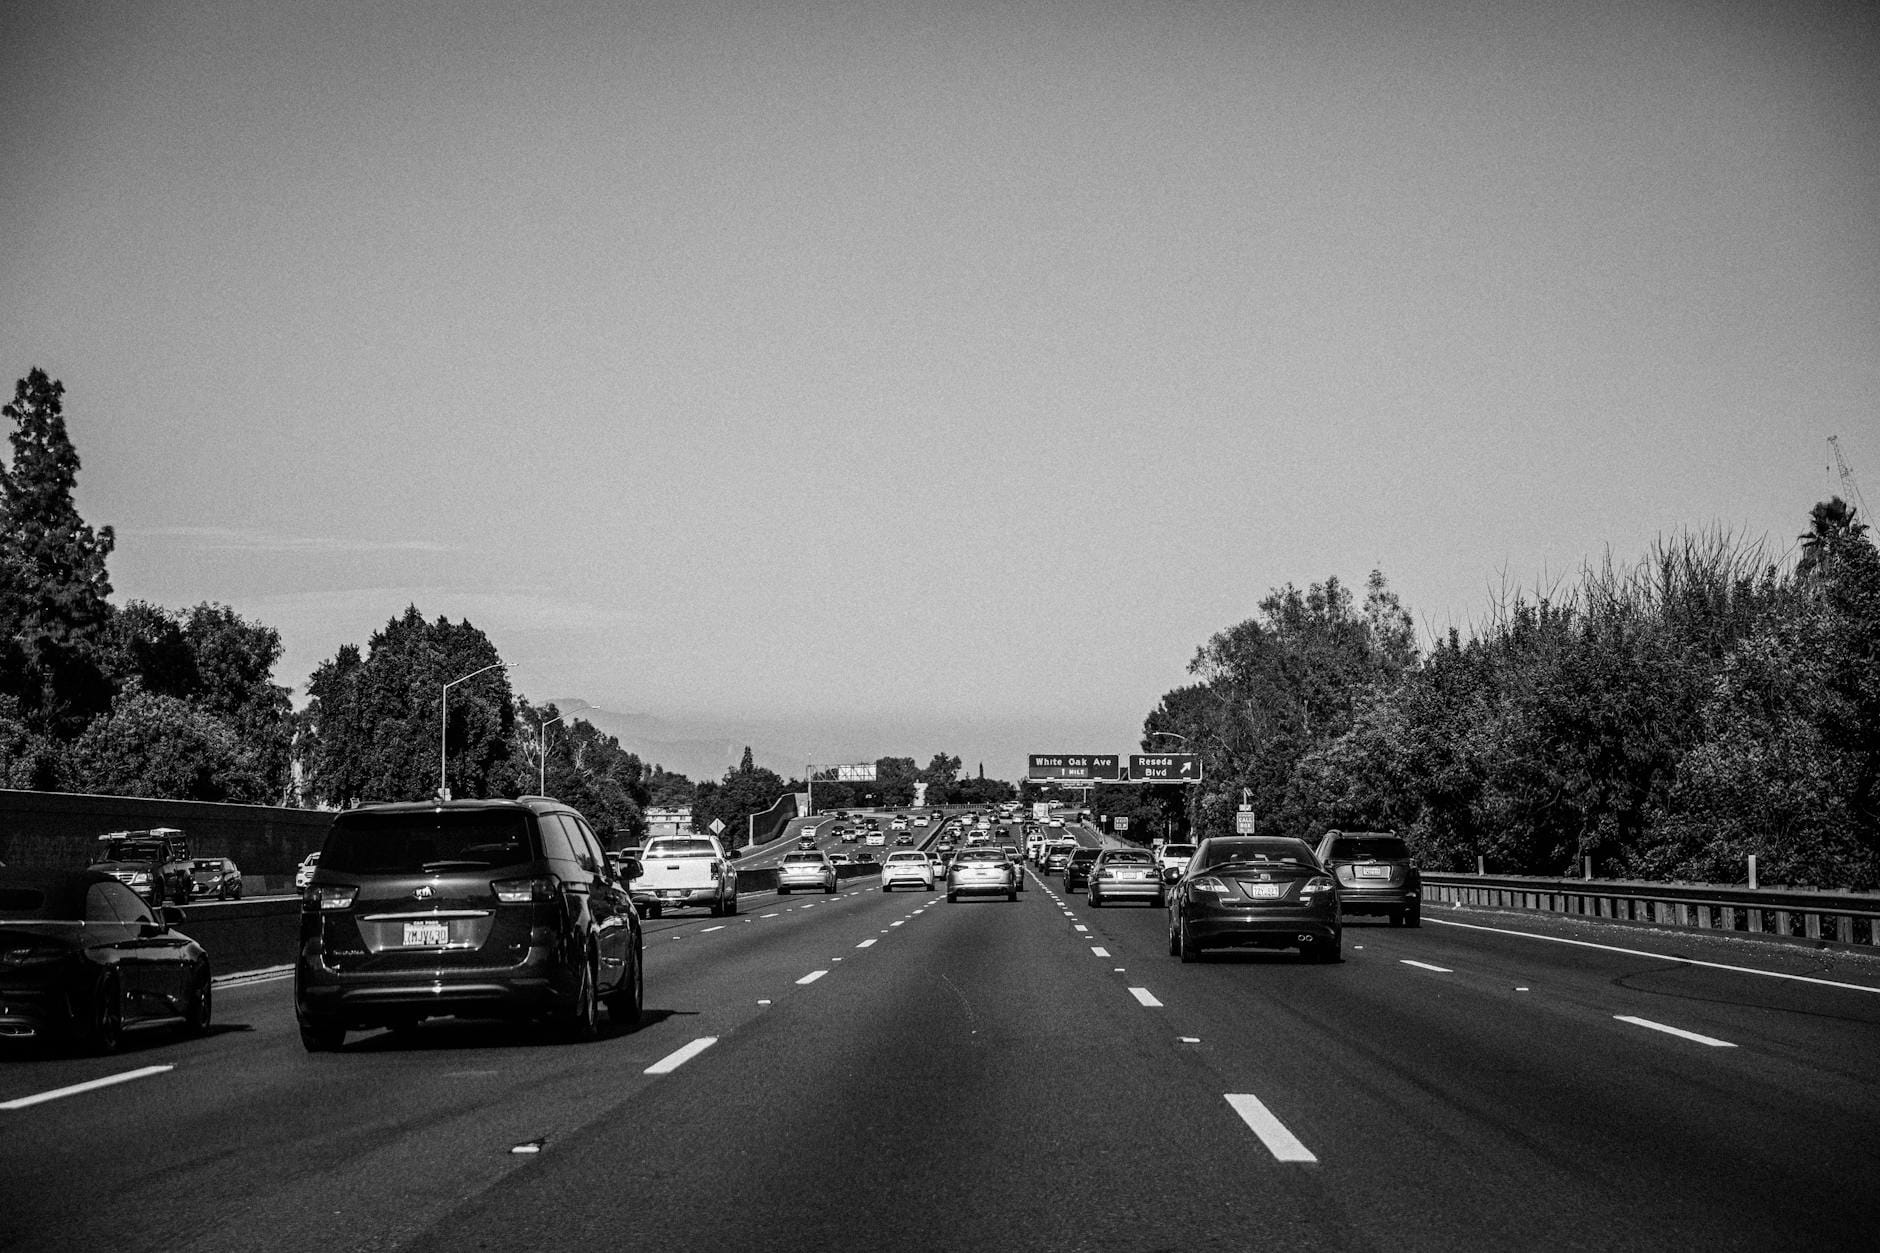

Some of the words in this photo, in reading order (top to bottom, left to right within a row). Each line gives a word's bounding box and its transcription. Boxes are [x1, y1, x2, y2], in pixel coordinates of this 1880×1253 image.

[1035, 757, 1063, 766] White
[1068, 757, 1088, 766] Oak
[1093, 757, 1112, 766] Ave
[1138, 757, 1173, 766] Reseda
[1061, 768, 1065, 776] 1
[1145, 768, 1167, 777] Blvd
[415, 886, 432, 897] KIA
